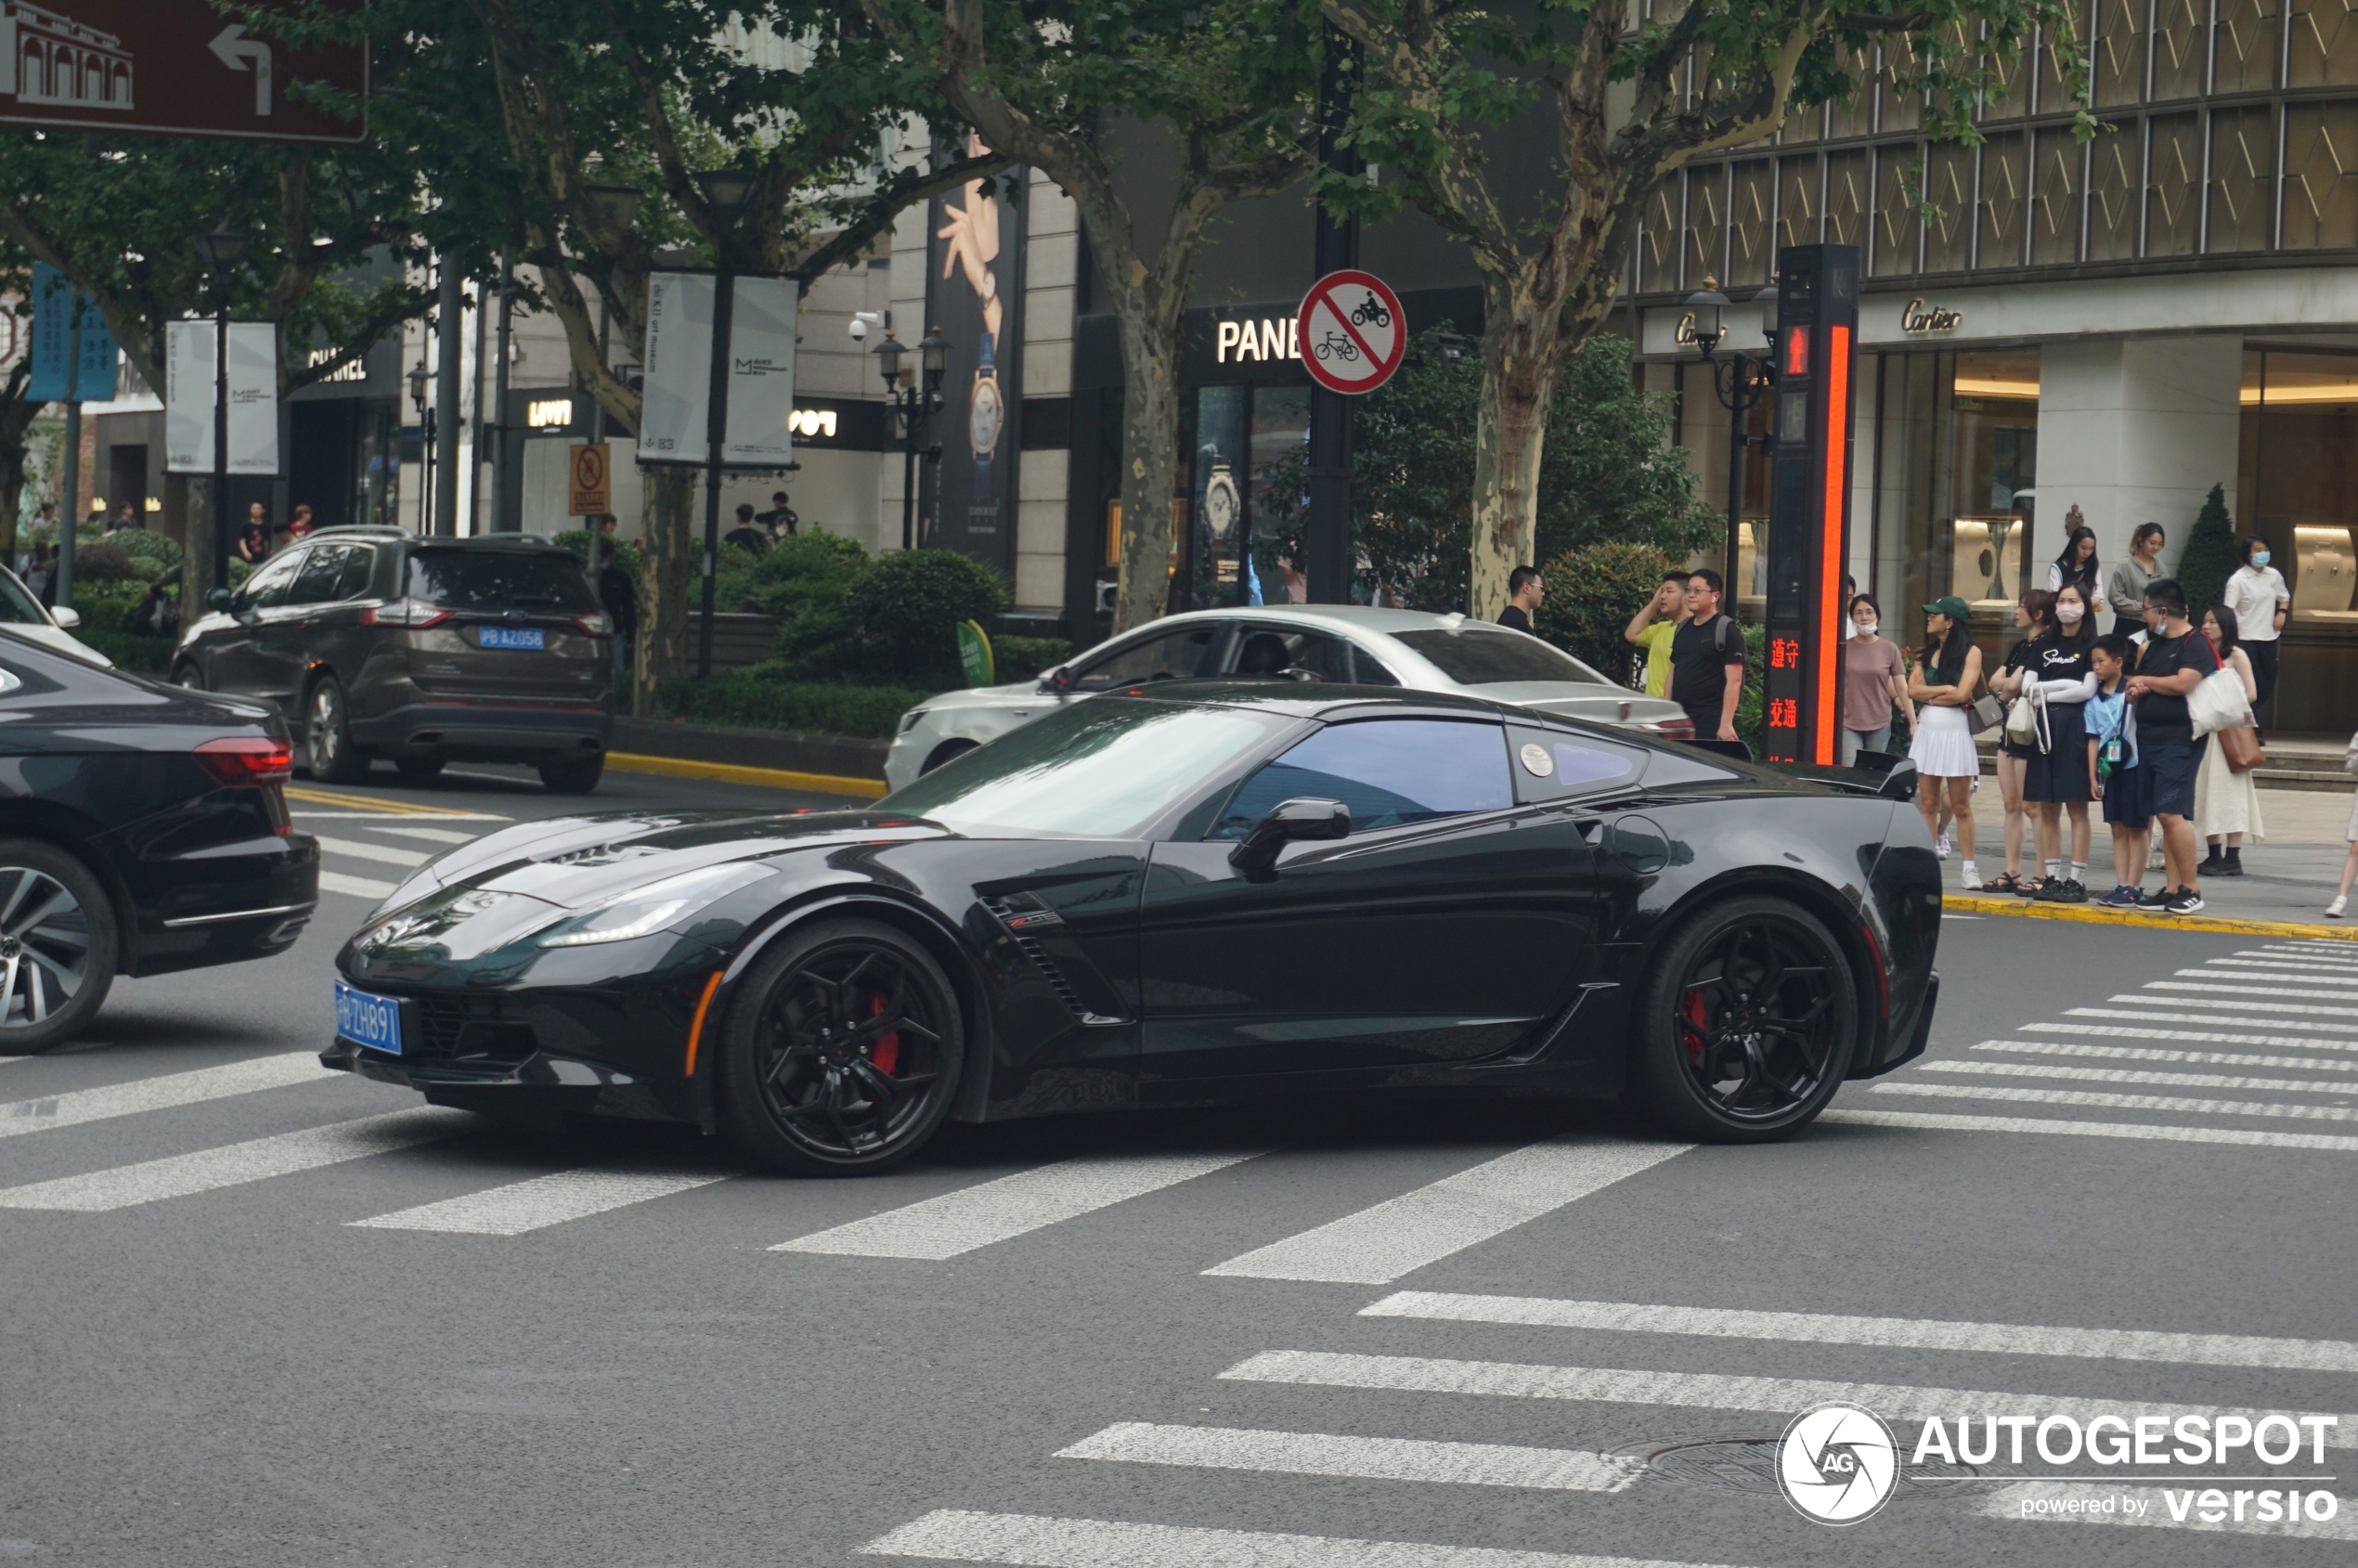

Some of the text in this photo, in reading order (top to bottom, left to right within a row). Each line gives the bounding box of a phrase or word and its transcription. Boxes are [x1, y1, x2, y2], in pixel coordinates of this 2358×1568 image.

[651, 320, 660, 332] art
[1901, 299, 1962, 331] Cartier
[649, 335, 658, 373] museum
[658, 437, 675, 450] B3
[1771, 638, 1799, 669] 遵守
[1769, 698, 1797, 728] 交通
